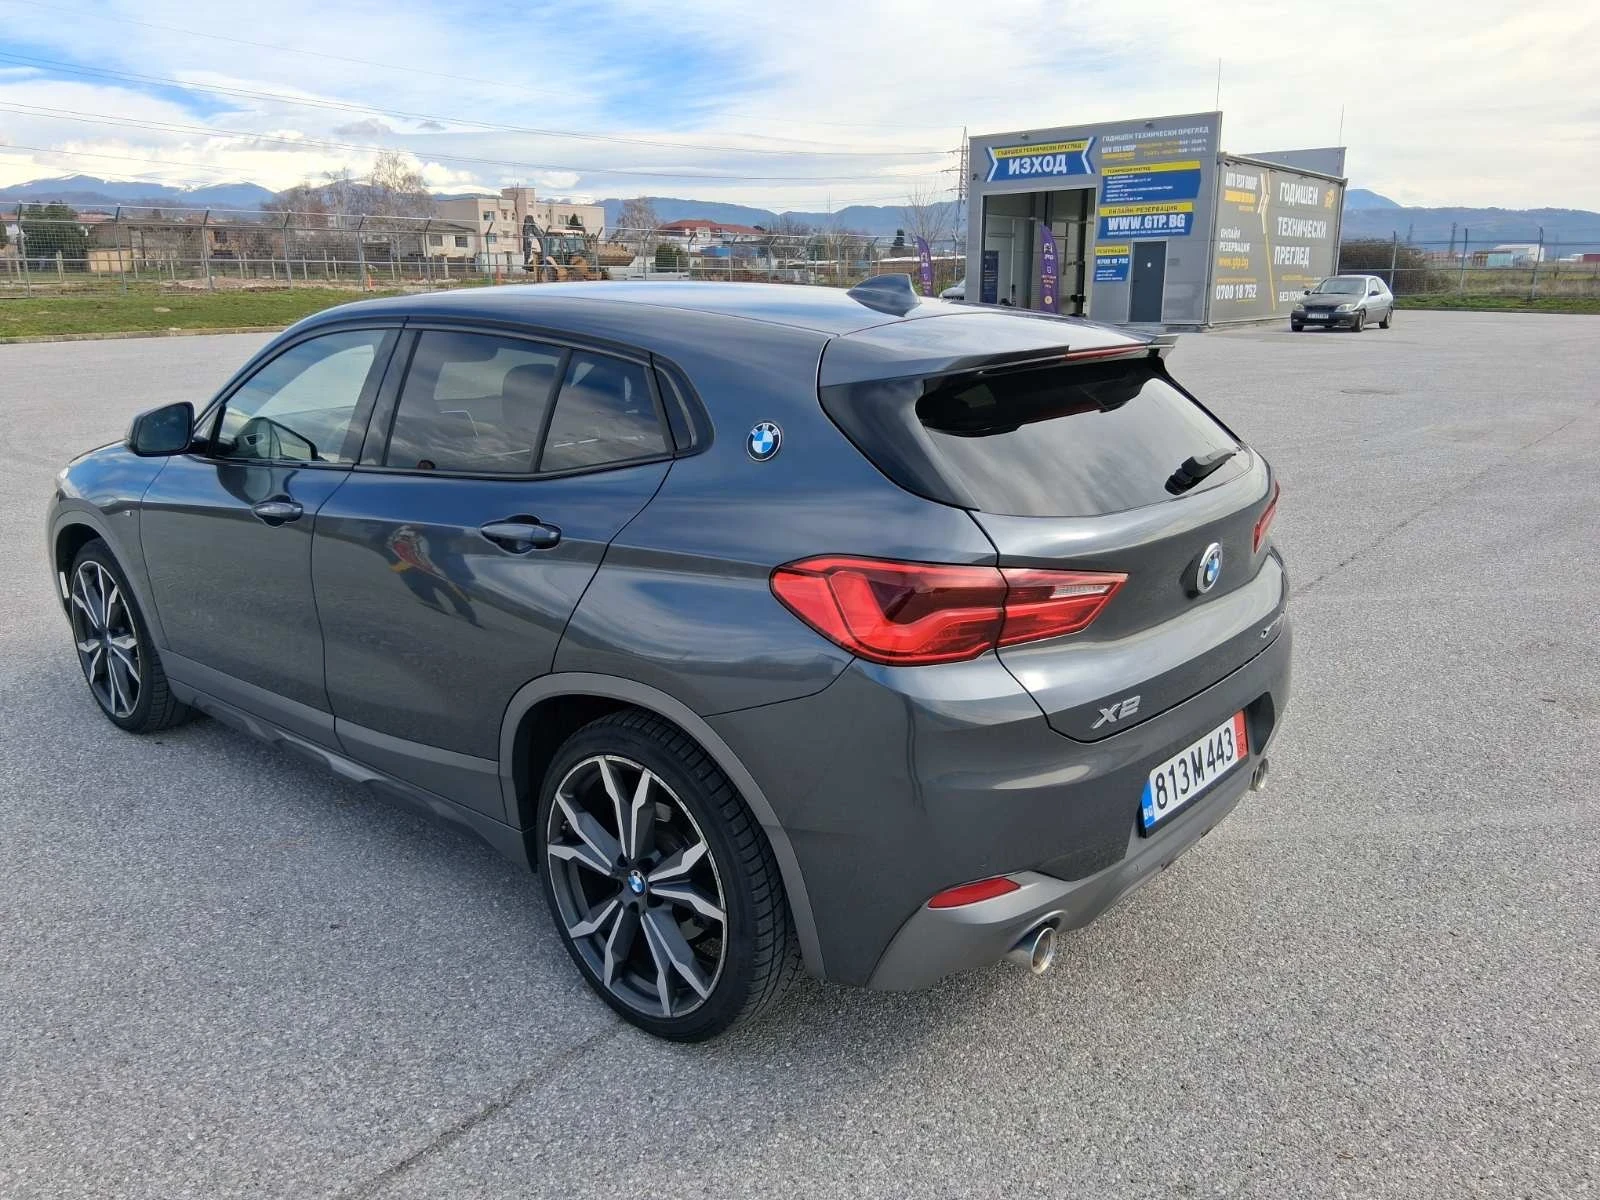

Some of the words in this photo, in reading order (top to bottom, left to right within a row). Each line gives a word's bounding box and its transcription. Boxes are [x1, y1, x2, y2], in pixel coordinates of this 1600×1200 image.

[1008, 154, 1067, 175] ИЗХОД
[1280, 182, 1319, 206] ГОДИШЕН
[1108, 213, 1186, 231] WWW.GTP.BG
[1278, 216, 1327, 239] ТЕХНИЧЕСКИ
[1274, 246, 1311, 269] ПРЕГЛЕД
[1216, 285, 1234, 300] 0700
[1244, 284, 1257, 298] 752
[1091, 695, 1141, 729] X2
